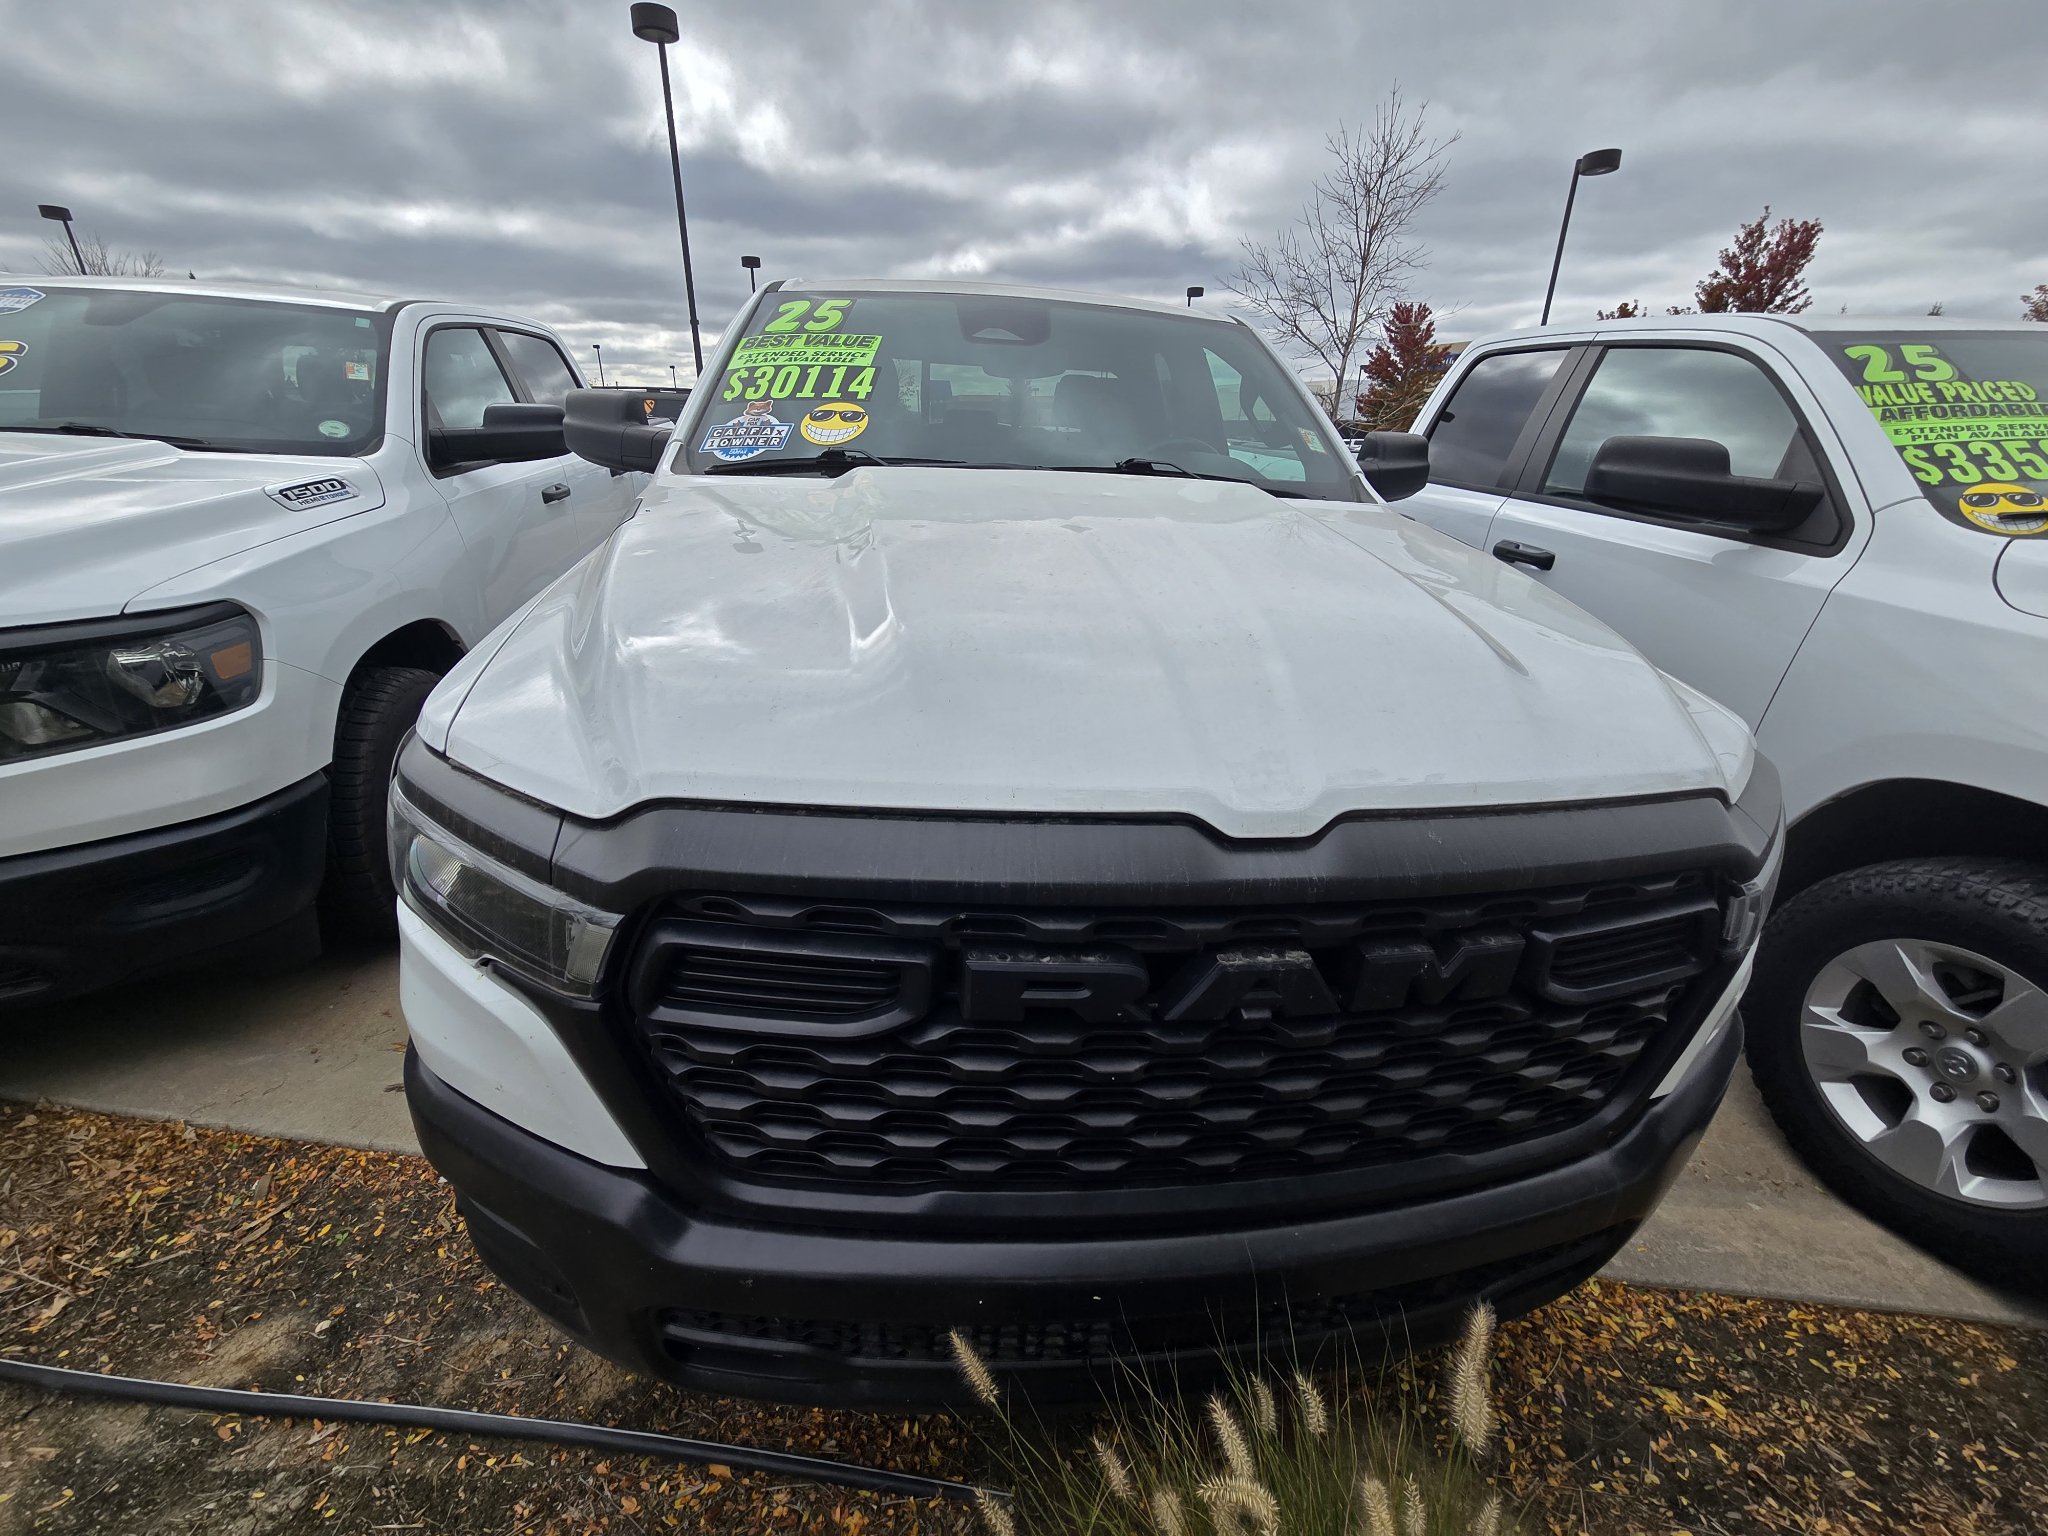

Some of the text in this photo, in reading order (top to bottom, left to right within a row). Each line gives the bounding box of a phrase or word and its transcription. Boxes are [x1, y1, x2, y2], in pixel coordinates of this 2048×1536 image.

[764, 299, 853, 334] 25
[740, 334, 876, 350] BEST VALUE
[737, 350, 869, 361] EXTENDED SERVICE
[743, 357, 779, 365] PLAN
[1844, 344, 1956, 382] 25
[723, 365, 875, 402] $30114
[1855, 381, 2038, 406] VALUE PRICED
[713, 428, 785, 437] CARFAX
[1893, 424, 1989, 436] EXTENDED
[1911, 433, 1959, 442] PLAN
[282, 480, 342, 500] 1500
[297, 496, 321, 506] HEMI
[960, 931, 1527, 1022] RAM
